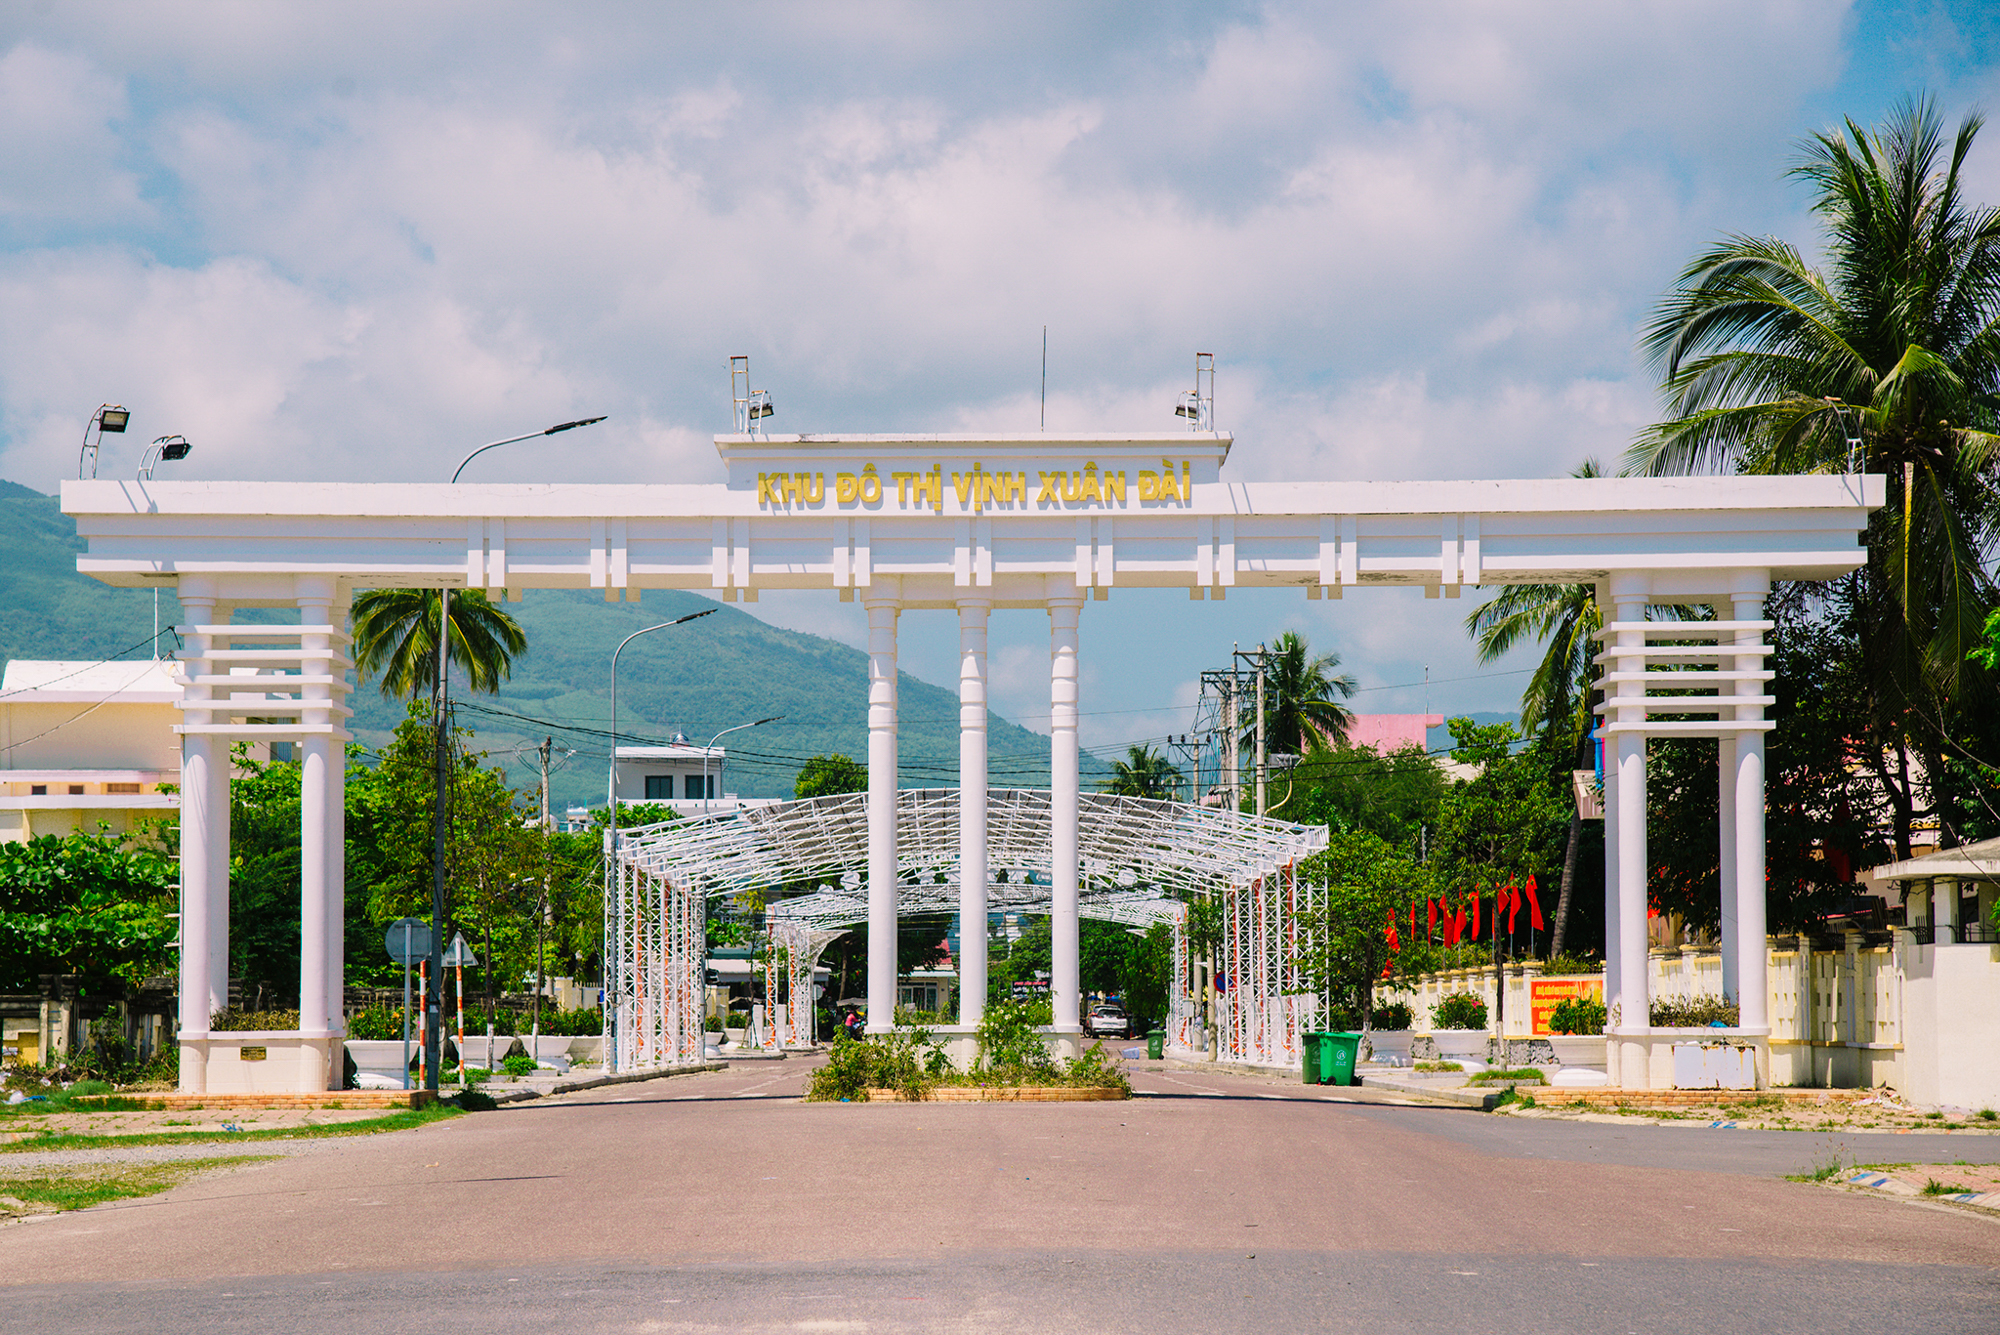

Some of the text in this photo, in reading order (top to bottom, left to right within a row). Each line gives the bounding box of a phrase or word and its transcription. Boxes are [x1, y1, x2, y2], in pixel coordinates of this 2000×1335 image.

[758, 472, 823, 503] KHU
[835, 462, 882, 503] ĐÔ
[891, 463, 942, 511] THỊ
[1036, 461, 1126, 502] XUÂN
[1138, 458, 1190, 501] ĐÀI
